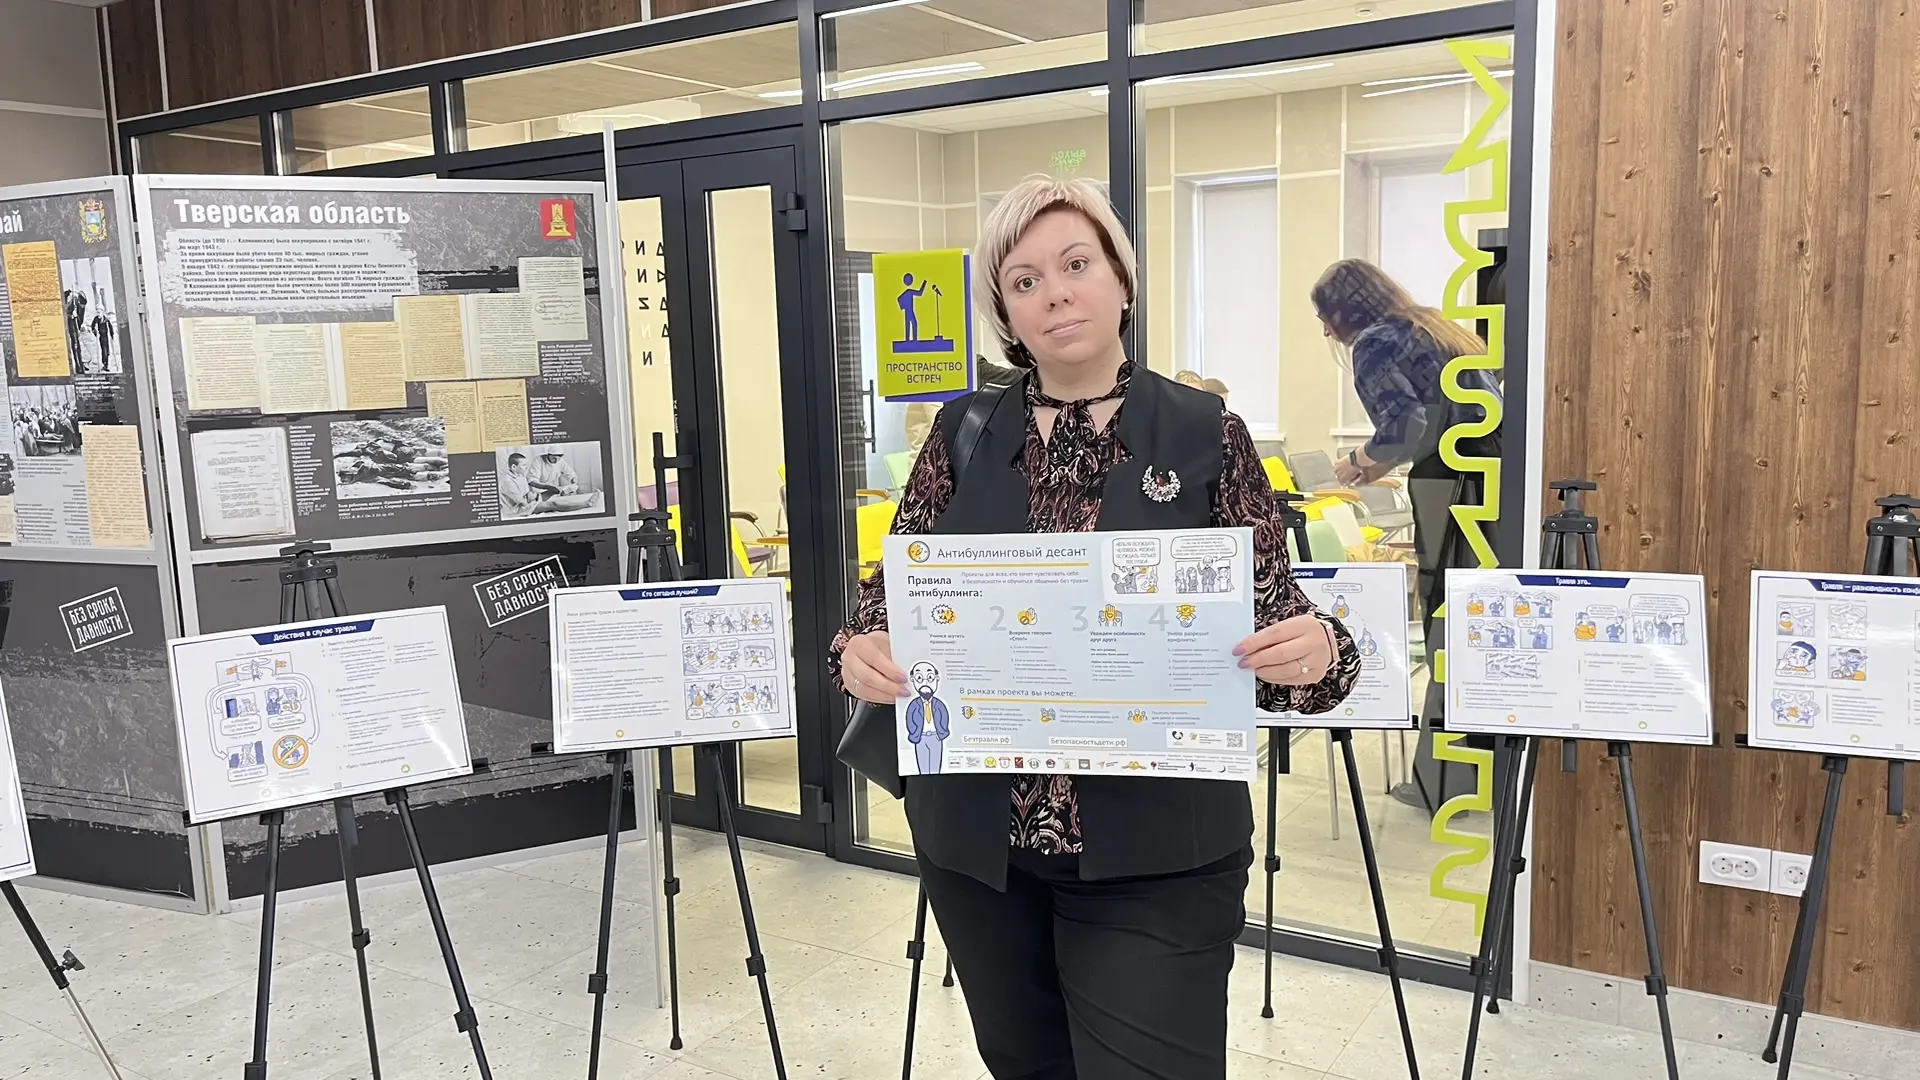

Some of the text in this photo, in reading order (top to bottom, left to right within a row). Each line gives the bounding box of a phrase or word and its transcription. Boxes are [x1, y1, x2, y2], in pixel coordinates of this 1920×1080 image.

[174, 199, 410, 228] Тверская область
[886, 362, 962, 372] ПРОСТРАНСТВО
[907, 374, 941, 384] ВСТРЕЧ
[937, 546, 1087, 560] Антибуллинговый десант
[486, 565, 554, 600] БЕЗ СРОКА
[907, 575, 952, 587] Правила
[1555, 577, 1576, 585] Травля
[1821, 582, 1843, 590] Травля
[494, 581, 558, 618] ДАВНОСТИ
[676, 588, 698, 597] лучший?
[908, 589, 983, 599] антибуллинга:
[69, 596, 117, 625] БЕЗ СРОКА
[910, 605, 927, 630] 1
[989, 606, 1006, 631] 2
[1072, 606, 1088, 631] 3
[1148, 605, 1169, 631] 4
[76, 614, 124, 644] ДАВНОСТИ
[273, 632, 305, 642] Действия
[312, 628, 333, 636] случае
[963, 736, 1010, 744] Безтравли.рф
[1051, 738, 1126, 747] Безопасностьдети.рф
